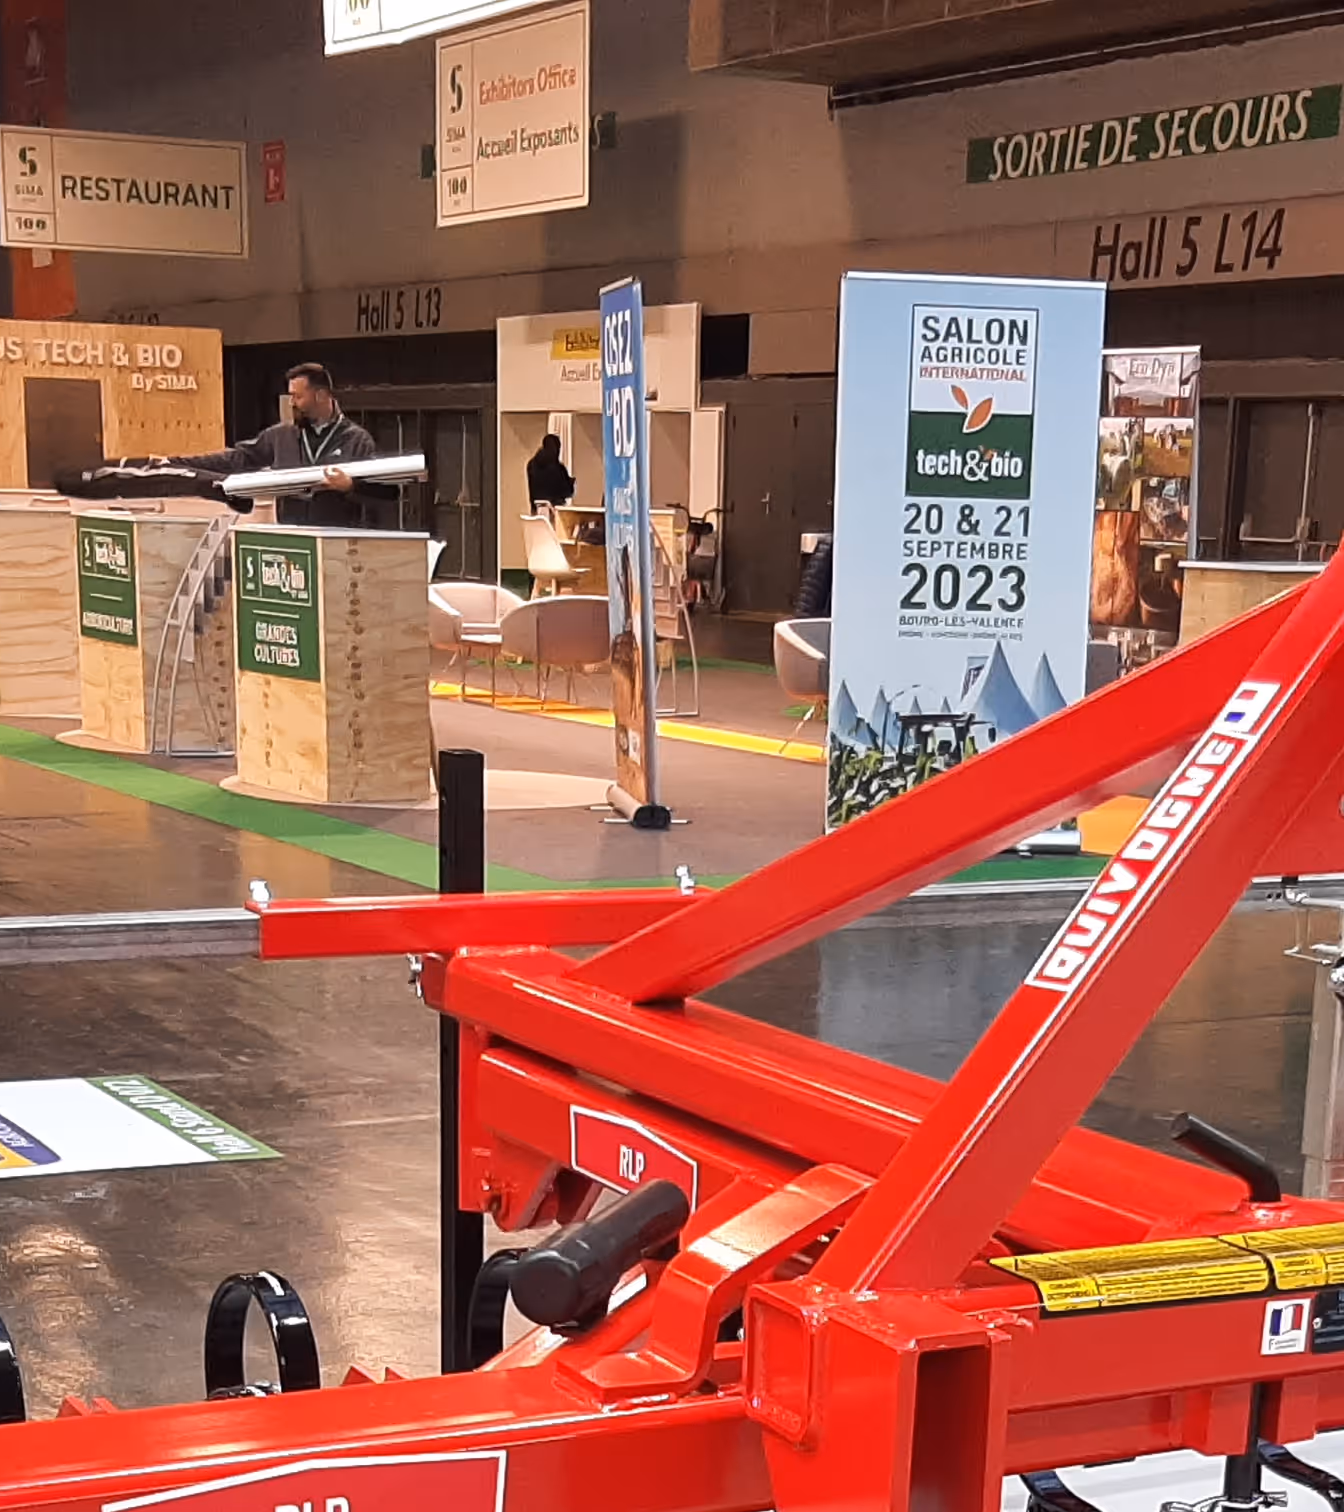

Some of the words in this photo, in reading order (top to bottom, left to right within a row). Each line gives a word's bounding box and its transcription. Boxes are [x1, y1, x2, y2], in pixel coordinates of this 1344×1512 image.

[480, 73, 535, 105] Exhibitors
[537, 64, 576, 92] Office
[477, 130, 518, 160] Accueil
[520, 121, 579, 156] Exposants
[989, 124, 1093, 181] SORTIE
[1097, 116, 1142, 167] DE
[1149, 90, 1312, 160] SECOURS
[60, 175, 234, 210] RESTAURANT
[1090, 215, 1167, 281] Hall
[1176, 216, 1201, 277] 5
[1214, 207, 1285, 273] L14
[357, 289, 390, 332] Hall
[394, 290, 405, 330] 5
[414, 287, 441, 328] L13
[604, 309, 633, 377] OSEZ
[921, 315, 1028, 346] SALON
[38, 337, 104, 366] TECH
[111, 342, 129, 367] &
[136, 343, 182, 368] BIO
[920, 345, 1027, 366] AGRICOLE
[130, 373, 153, 393] By
[158, 374, 198, 391] SIMA
[919, 366, 1027, 381] INTERNATIONAL
[916, 449, 1023, 482] tech&bio
[903, 503, 943, 535] 20
[957, 504, 981, 535] &
[993, 505, 1030, 537] 21
[903, 540, 1028, 560] SEPTEMBRE
[900, 562, 1026, 612] 2023
[1043, 739, 1235, 979] QUIVOGNE
[192, 1134, 259, 1154] Hall
[619, 1144, 645, 1184] RLP
